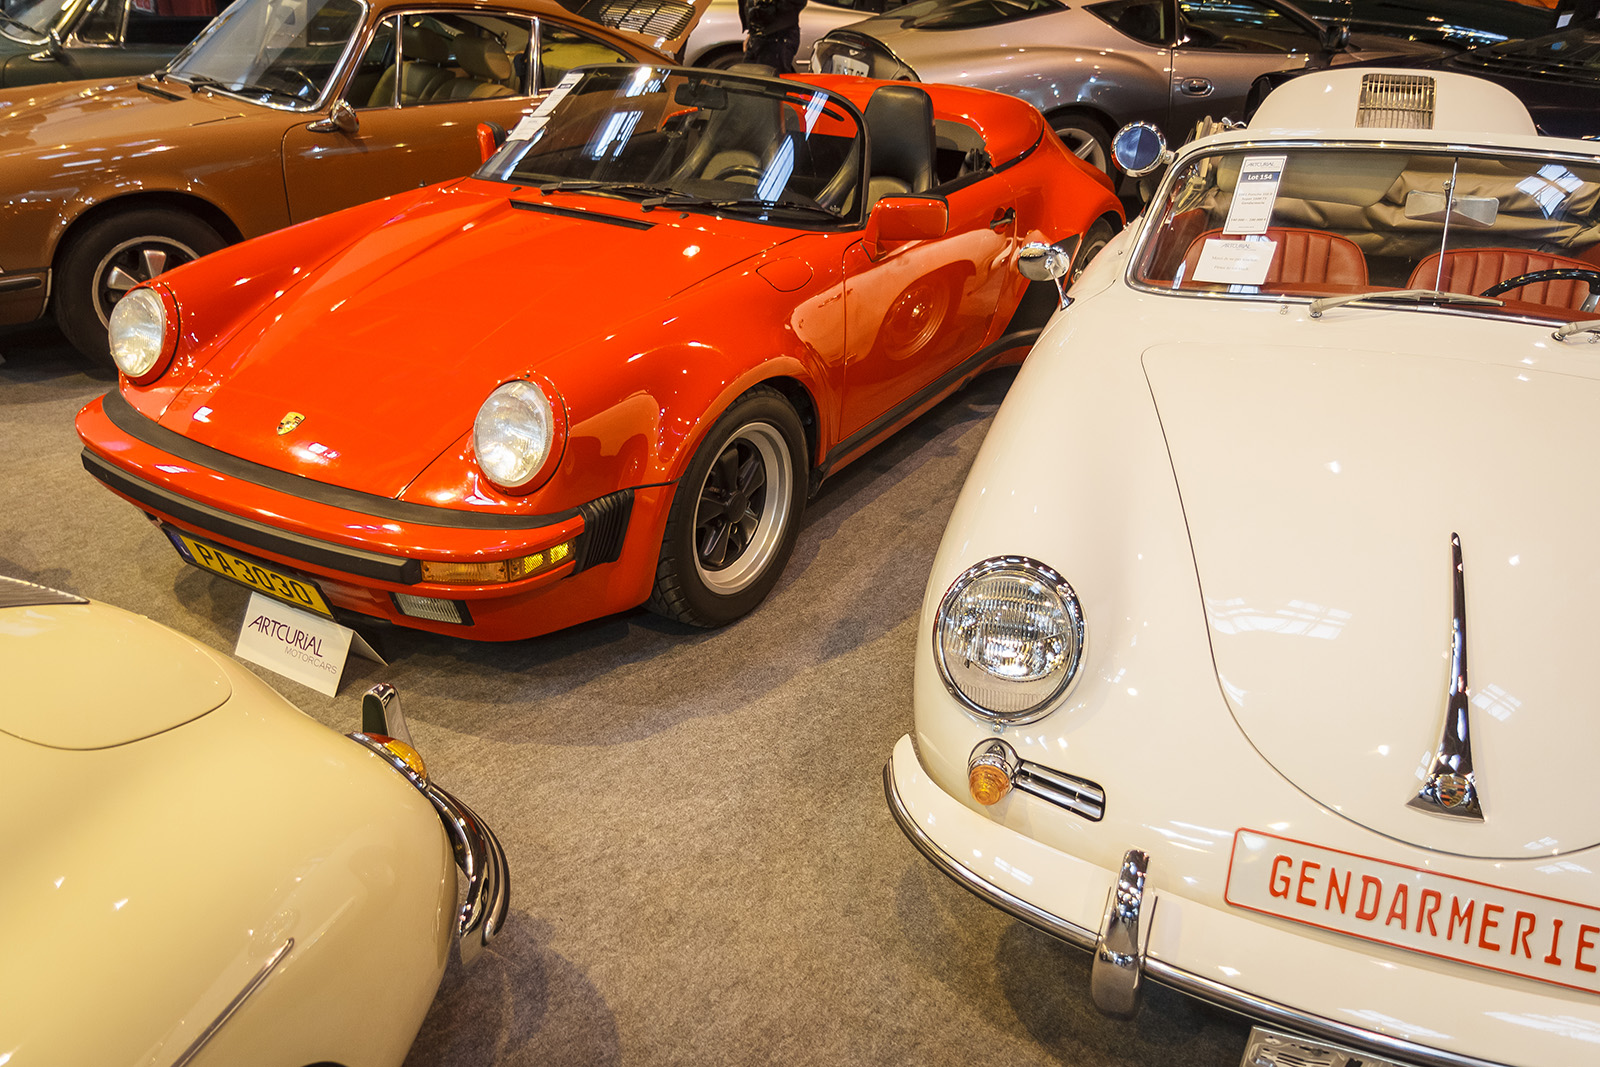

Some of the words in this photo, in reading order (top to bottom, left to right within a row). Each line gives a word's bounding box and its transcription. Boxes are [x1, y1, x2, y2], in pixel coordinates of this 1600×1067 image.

[234, 559, 314, 605] 3030
[284, 646, 338, 675] MOTORCARS
[1268, 854, 1600, 973] GENDARMERIE
